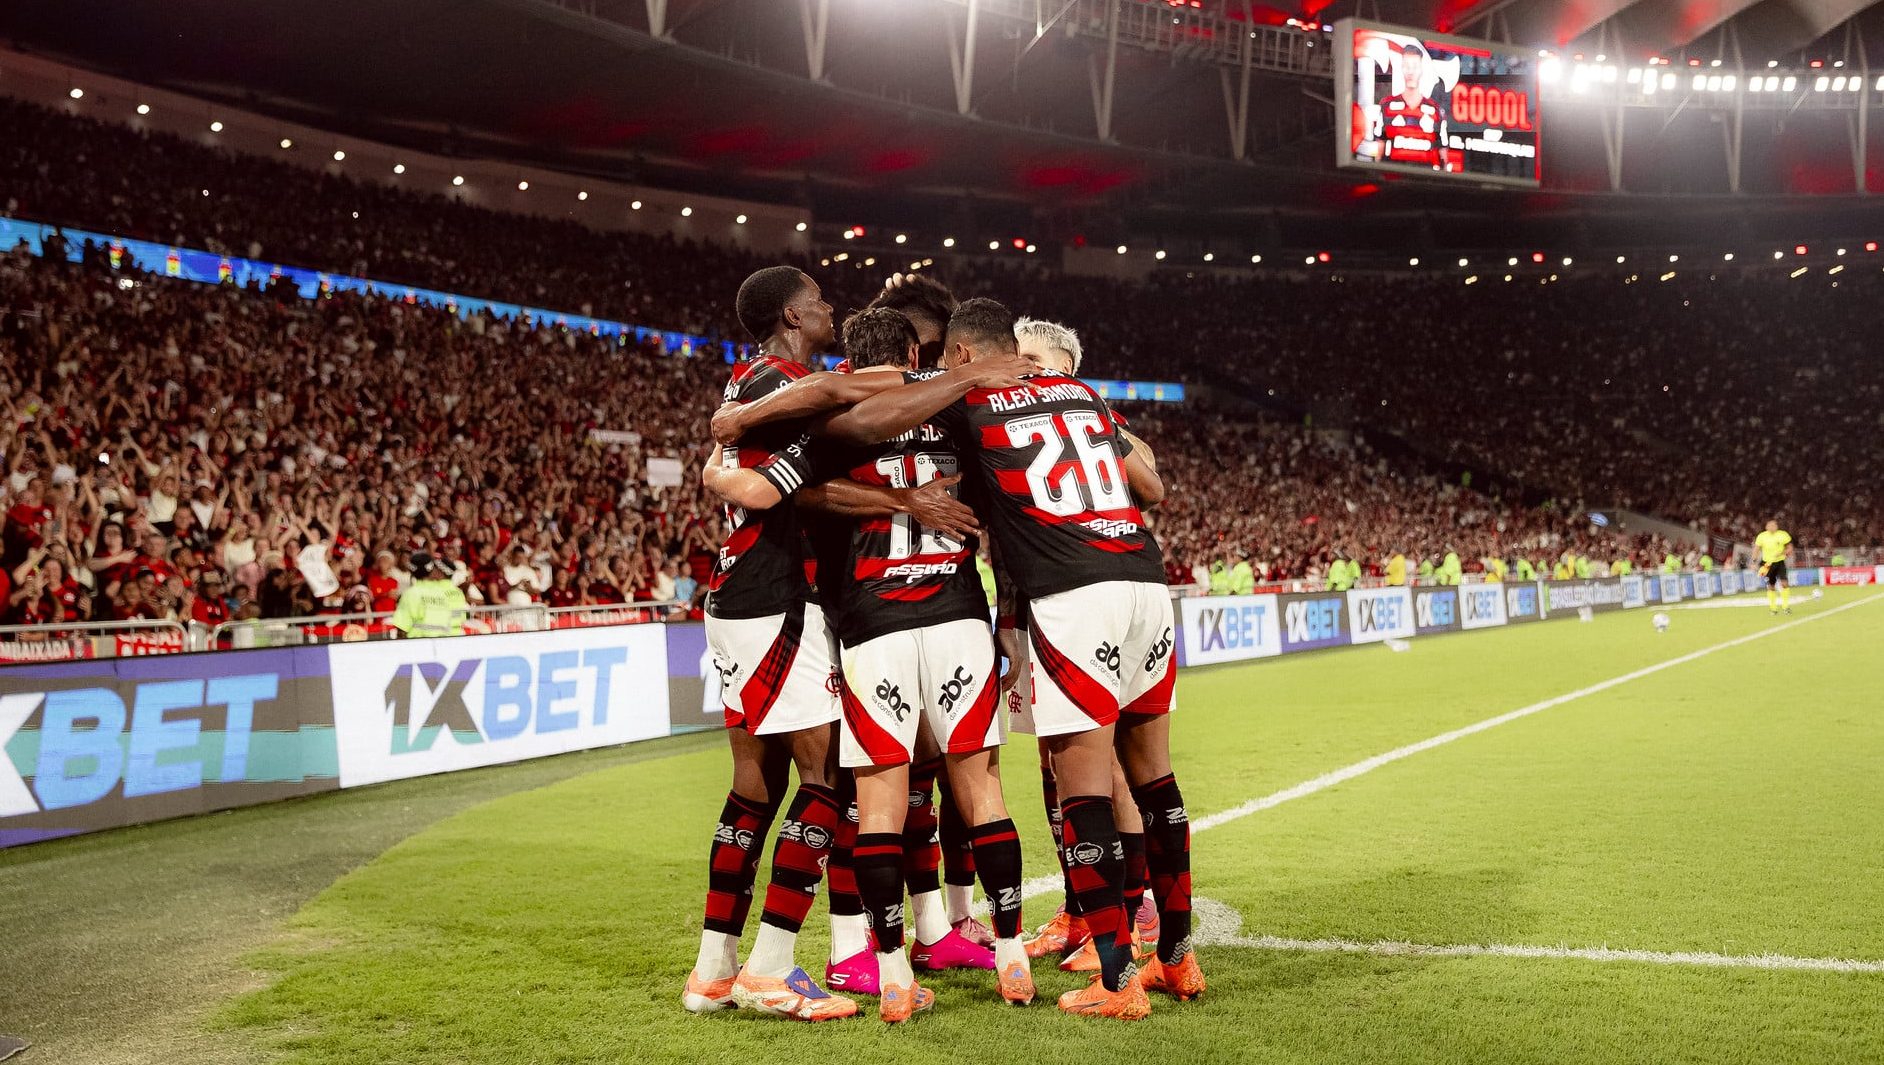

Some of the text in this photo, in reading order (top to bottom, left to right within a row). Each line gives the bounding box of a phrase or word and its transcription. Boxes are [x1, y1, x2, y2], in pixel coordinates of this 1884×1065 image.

[1452, 82, 1532, 131] GOOOL
[987, 388, 1038, 413] ALEX
[1019, 420, 1049, 430] TEXACO
[1005, 410, 1131, 516] 26
[1199, 605, 1266, 652] 1XBET
[1285, 599, 1342, 643] 1XBET
[1359, 596, 1404, 632] 1XBET
[1095, 641, 1110, 680] ab
[384, 646, 628, 756] 1XBET
[875, 678, 911, 723] abc
[938, 665, 973, 714] abc
